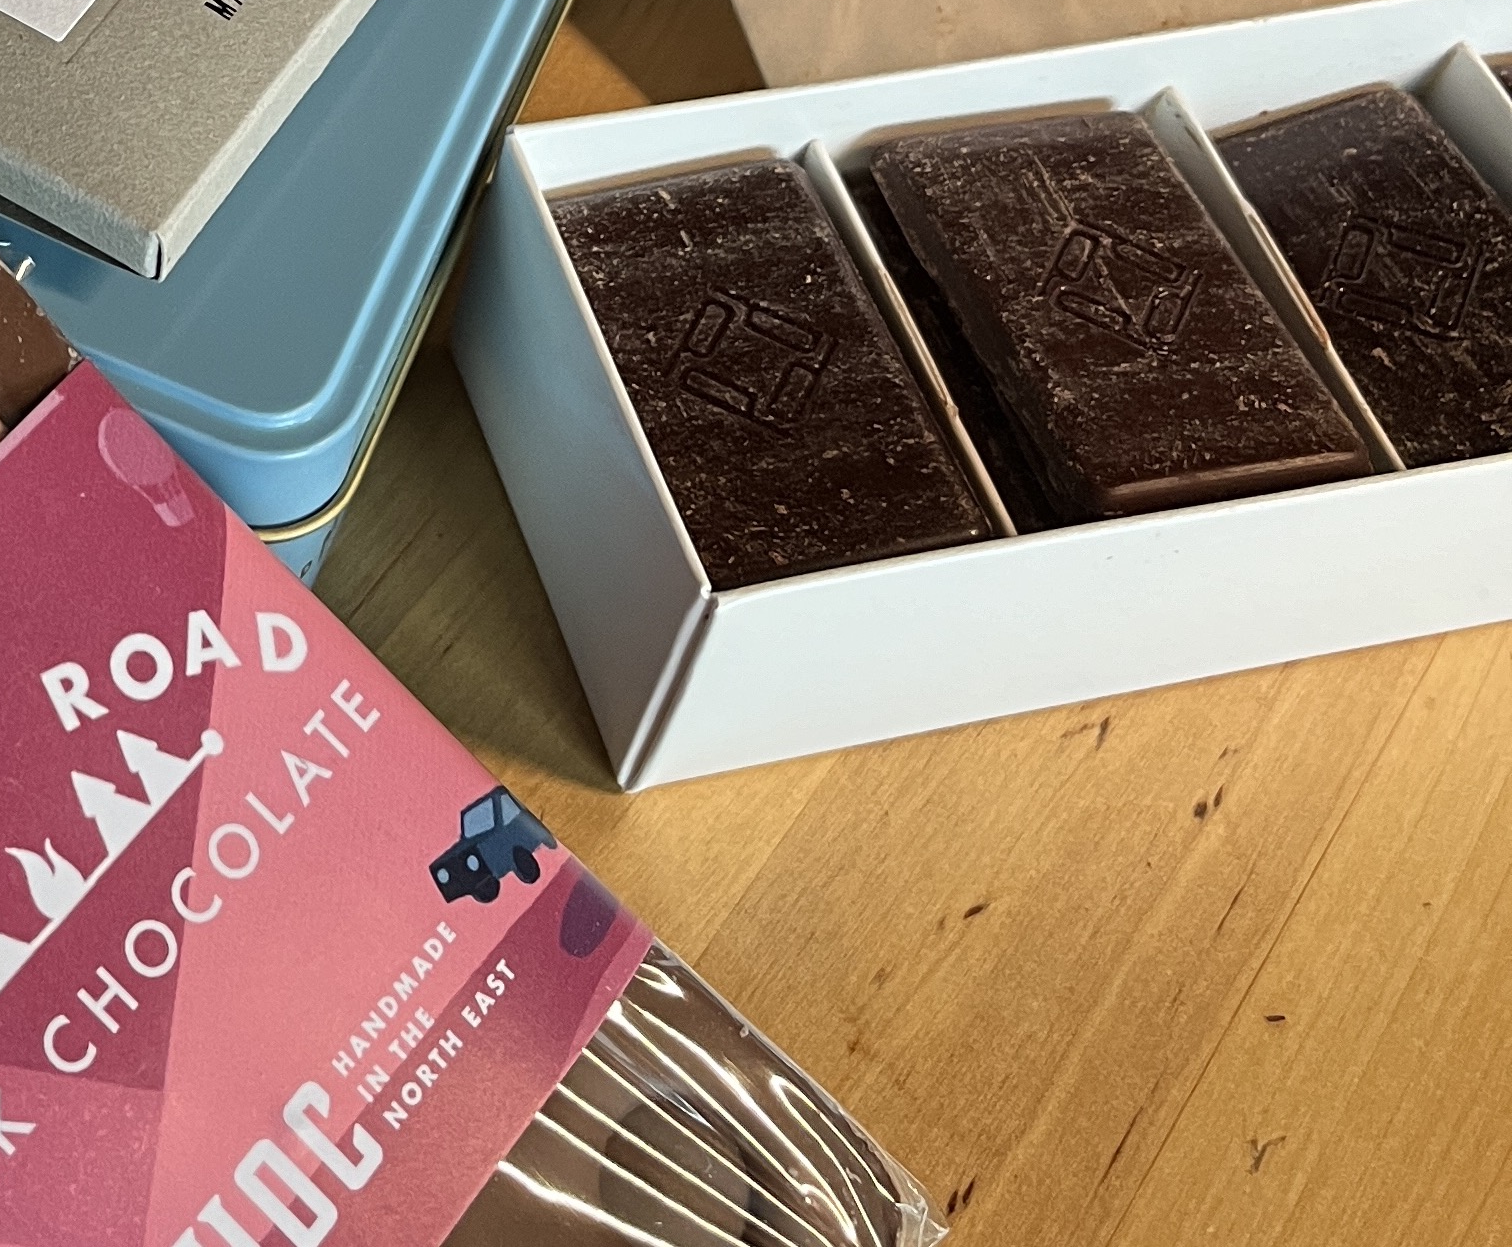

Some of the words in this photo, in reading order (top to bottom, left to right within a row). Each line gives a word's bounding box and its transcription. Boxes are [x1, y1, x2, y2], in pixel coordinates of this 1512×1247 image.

[41, 608, 308, 732] ROAD
[42, 679, 381, 1073] CHOCOLATE
[332, 921, 458, 1078] HANDMADE
[356, 1067, 390, 1103] IN
[388, 1007, 435, 1064] THE
[382, 1031, 463, 1130] NORTH
[461, 958, 517, 1029] EAST
